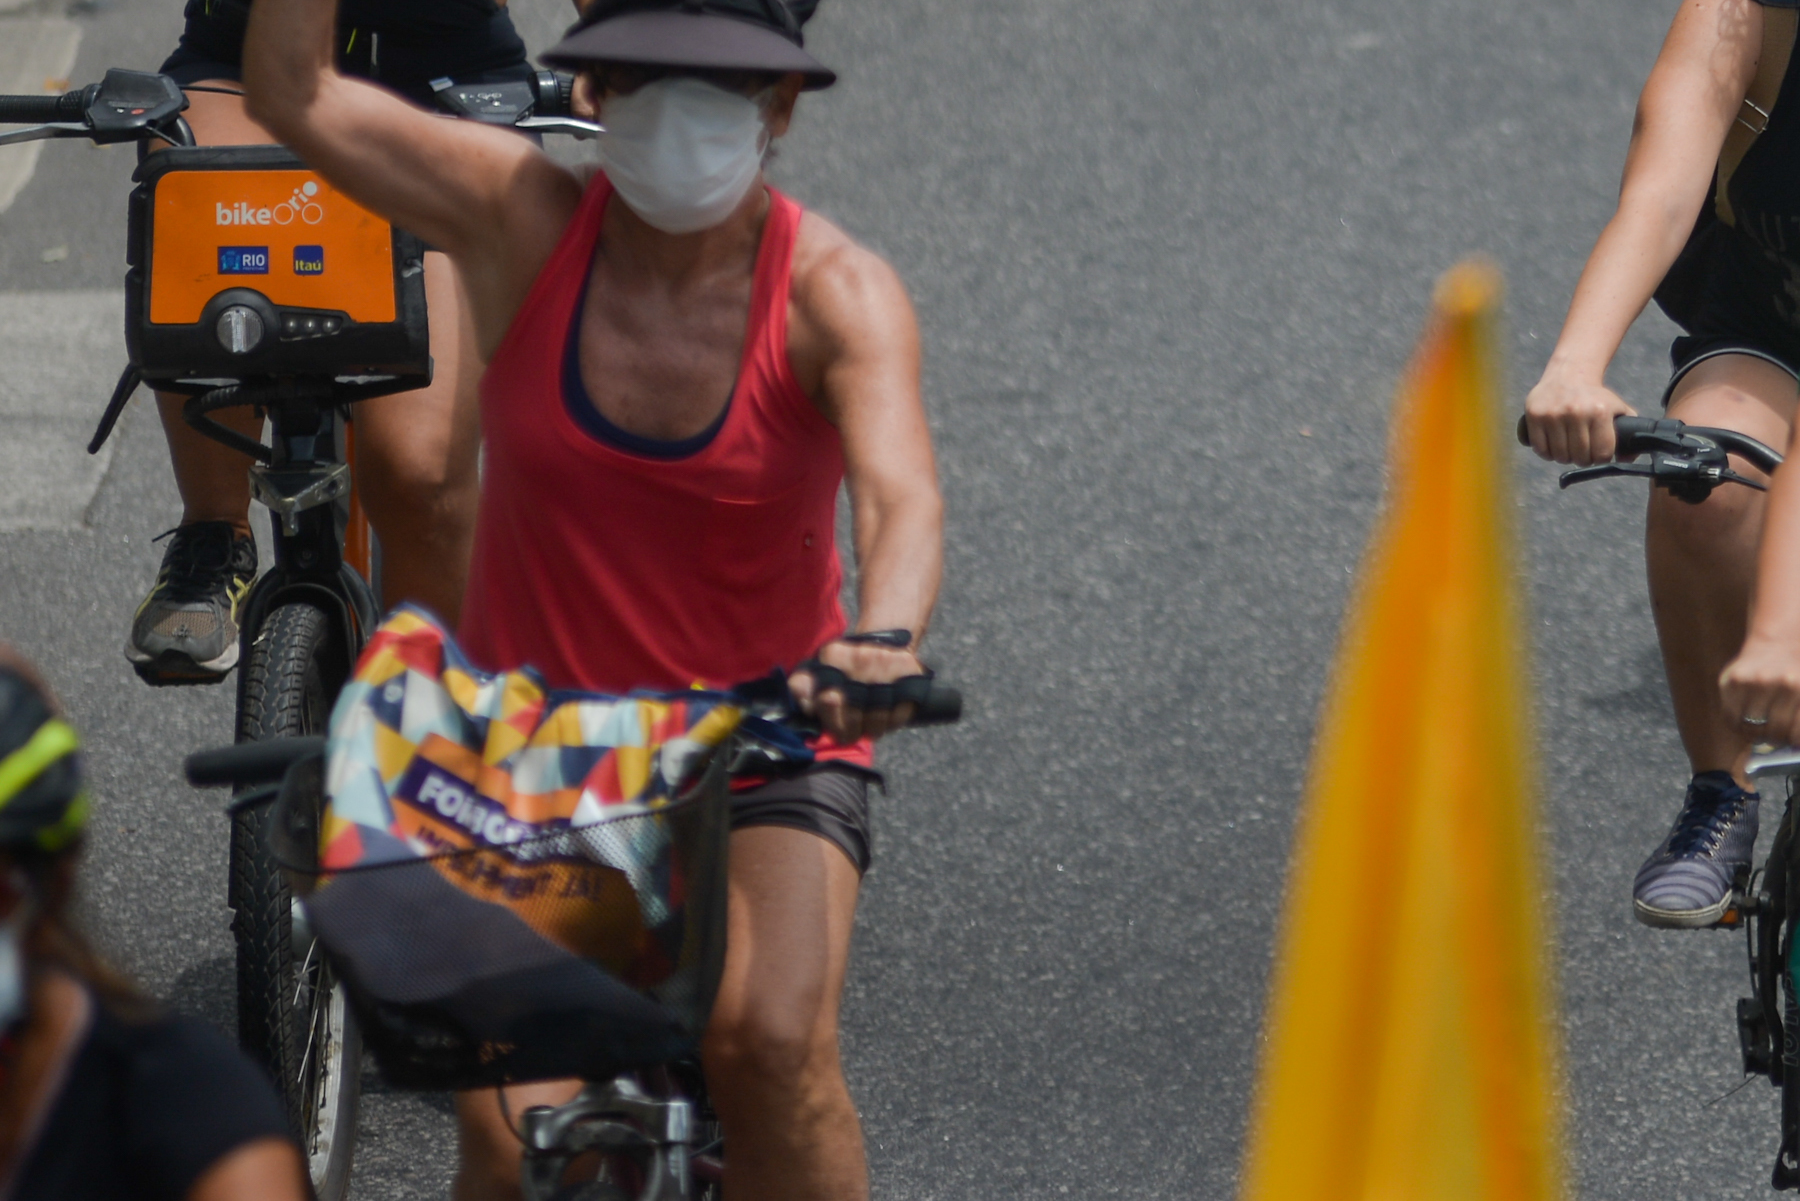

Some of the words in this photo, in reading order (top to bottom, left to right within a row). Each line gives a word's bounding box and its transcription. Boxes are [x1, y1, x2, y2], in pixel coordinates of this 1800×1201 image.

[216, 202, 271, 225] bike
[242, 254, 265, 267] RIO
[295, 259, 321, 271] Itaú
